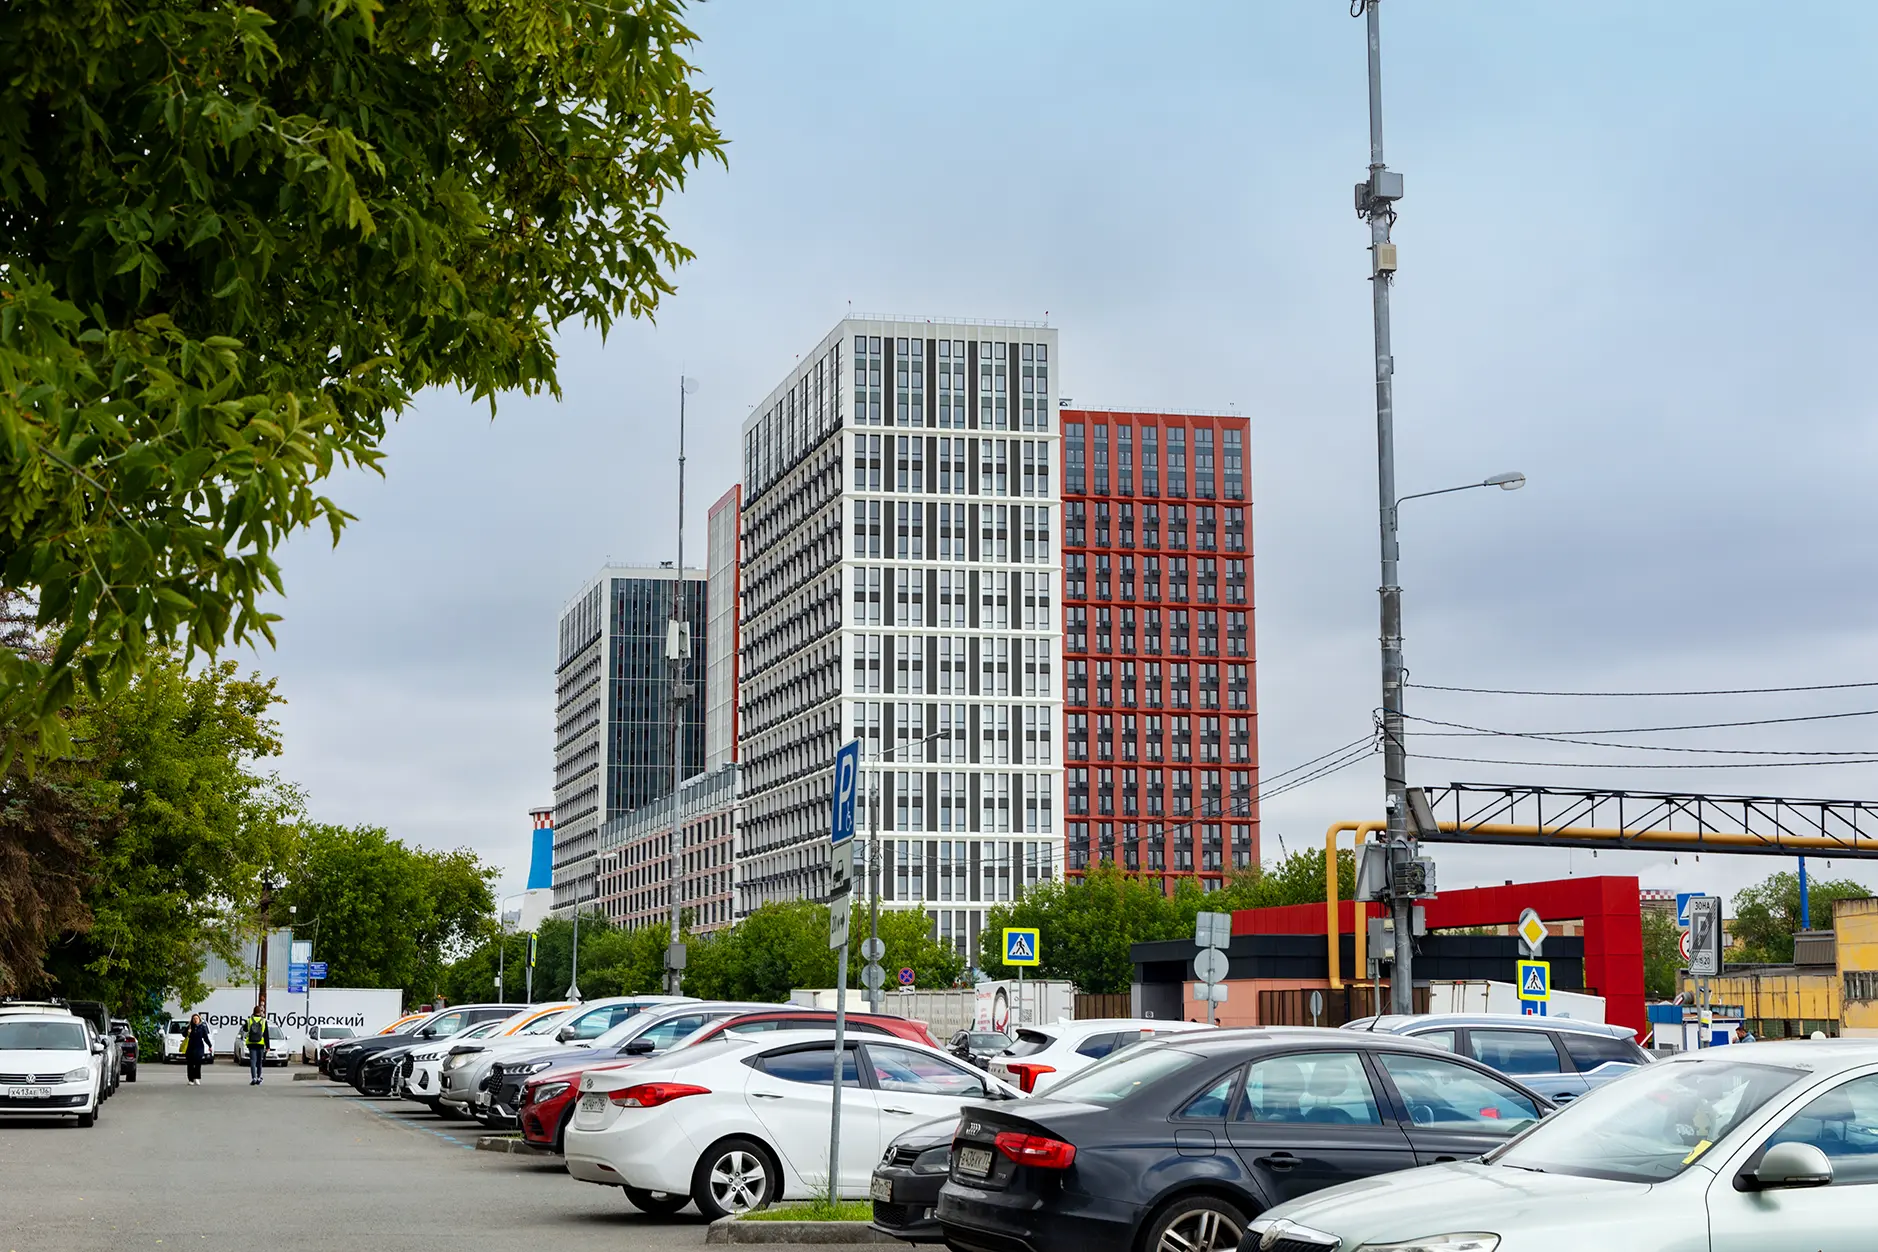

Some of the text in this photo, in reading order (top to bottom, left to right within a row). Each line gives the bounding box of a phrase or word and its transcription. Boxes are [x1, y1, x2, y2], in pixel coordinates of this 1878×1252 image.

[838, 754, 854, 832] P
[1694, 901, 1710, 911] ЗОНА
[198, 1012, 364, 1029] Первы Дубровский
